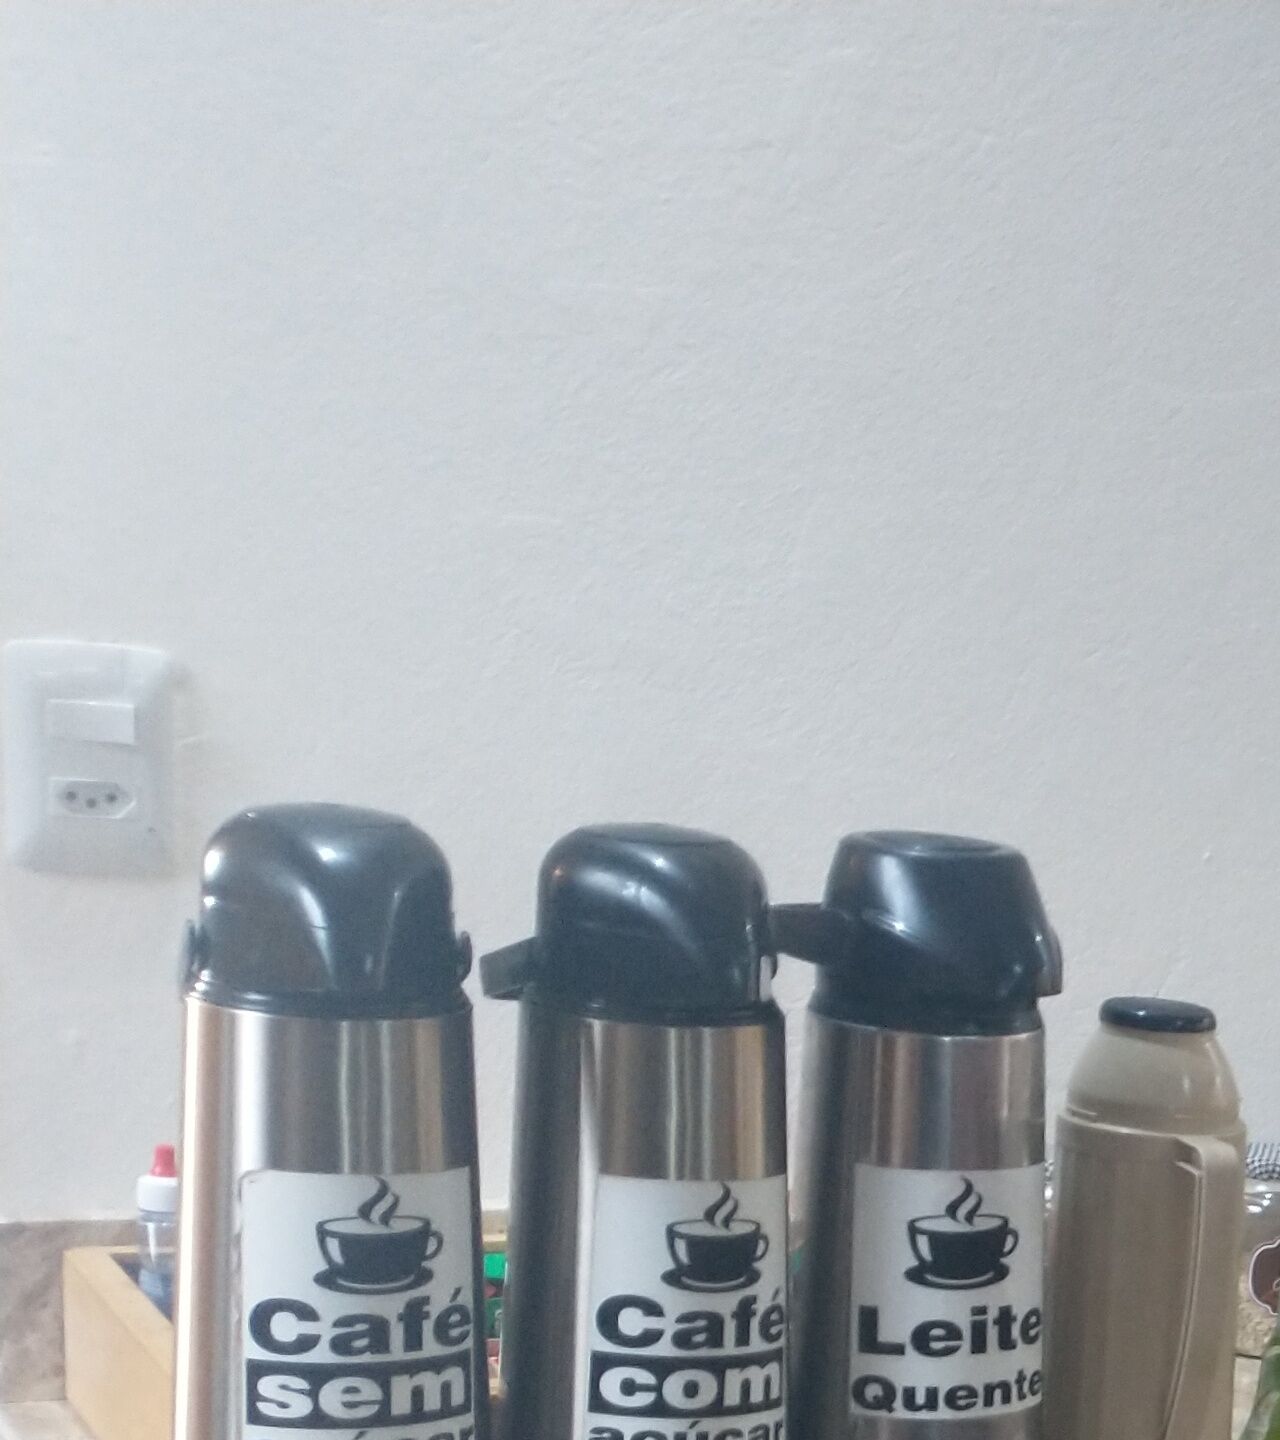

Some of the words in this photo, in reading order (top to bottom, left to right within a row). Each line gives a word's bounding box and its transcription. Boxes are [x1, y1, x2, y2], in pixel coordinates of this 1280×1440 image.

[249, 1287, 472, 1356] Café
[595, 1287, 784, 1350] Café
[858, 1304, 1042, 1358] Leite
[256, 1365, 466, 1420] sem
[599, 1361, 781, 1410] com
[852, 1368, 1042, 1413] Quente
